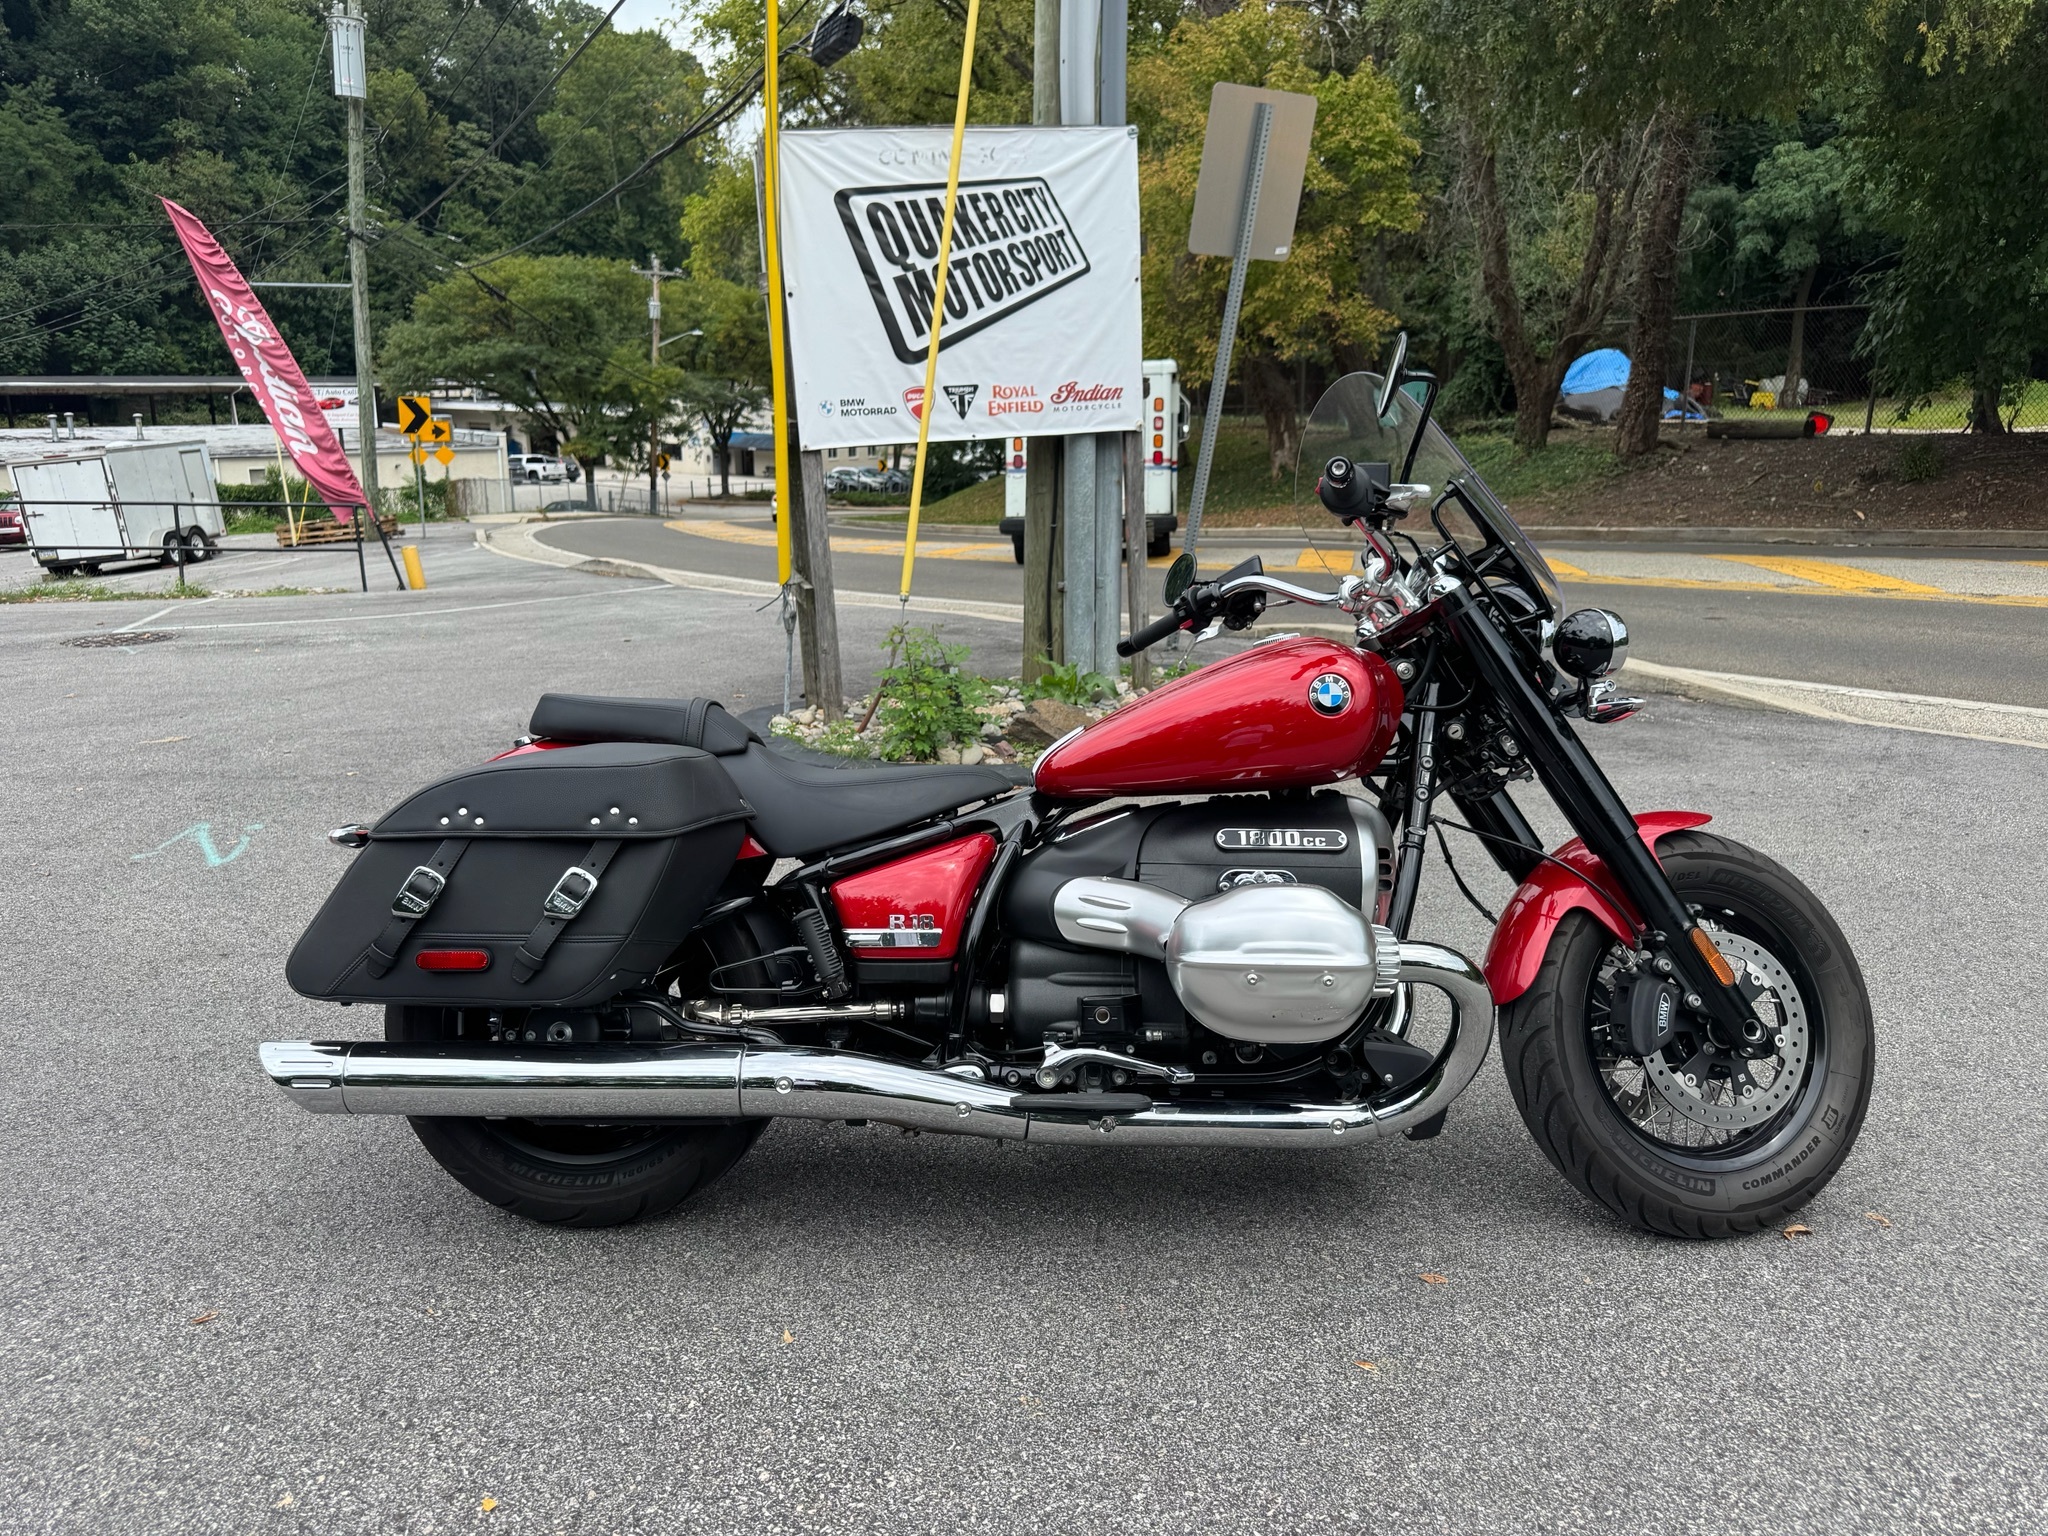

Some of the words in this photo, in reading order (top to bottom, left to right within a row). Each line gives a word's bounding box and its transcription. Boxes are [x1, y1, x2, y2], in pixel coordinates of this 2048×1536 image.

[866, 191, 1016, 272] QUAKER
[1002, 186, 1058, 233] CITY
[892, 229, 1078, 338] MOTORSPORT
[840, 398, 865, 407] BMW
[992, 384, 1038, 399] ROYAL
[1050, 381, 1124, 404] Indian
[840, 406, 898, 417] MOTORRAD
[988, 400, 1044, 416] ENFIELD
[1053, 402, 1122, 413] MOTORCYCLE
[1313, 676, 1347, 690] BMW
[1659, 1000, 1669, 1027] BMW
[508, 1161, 610, 1187] MICHELIN
[1616, 1135, 1712, 1192] MICHELIN
[1742, 1135, 1822, 1191] COMMANDER
